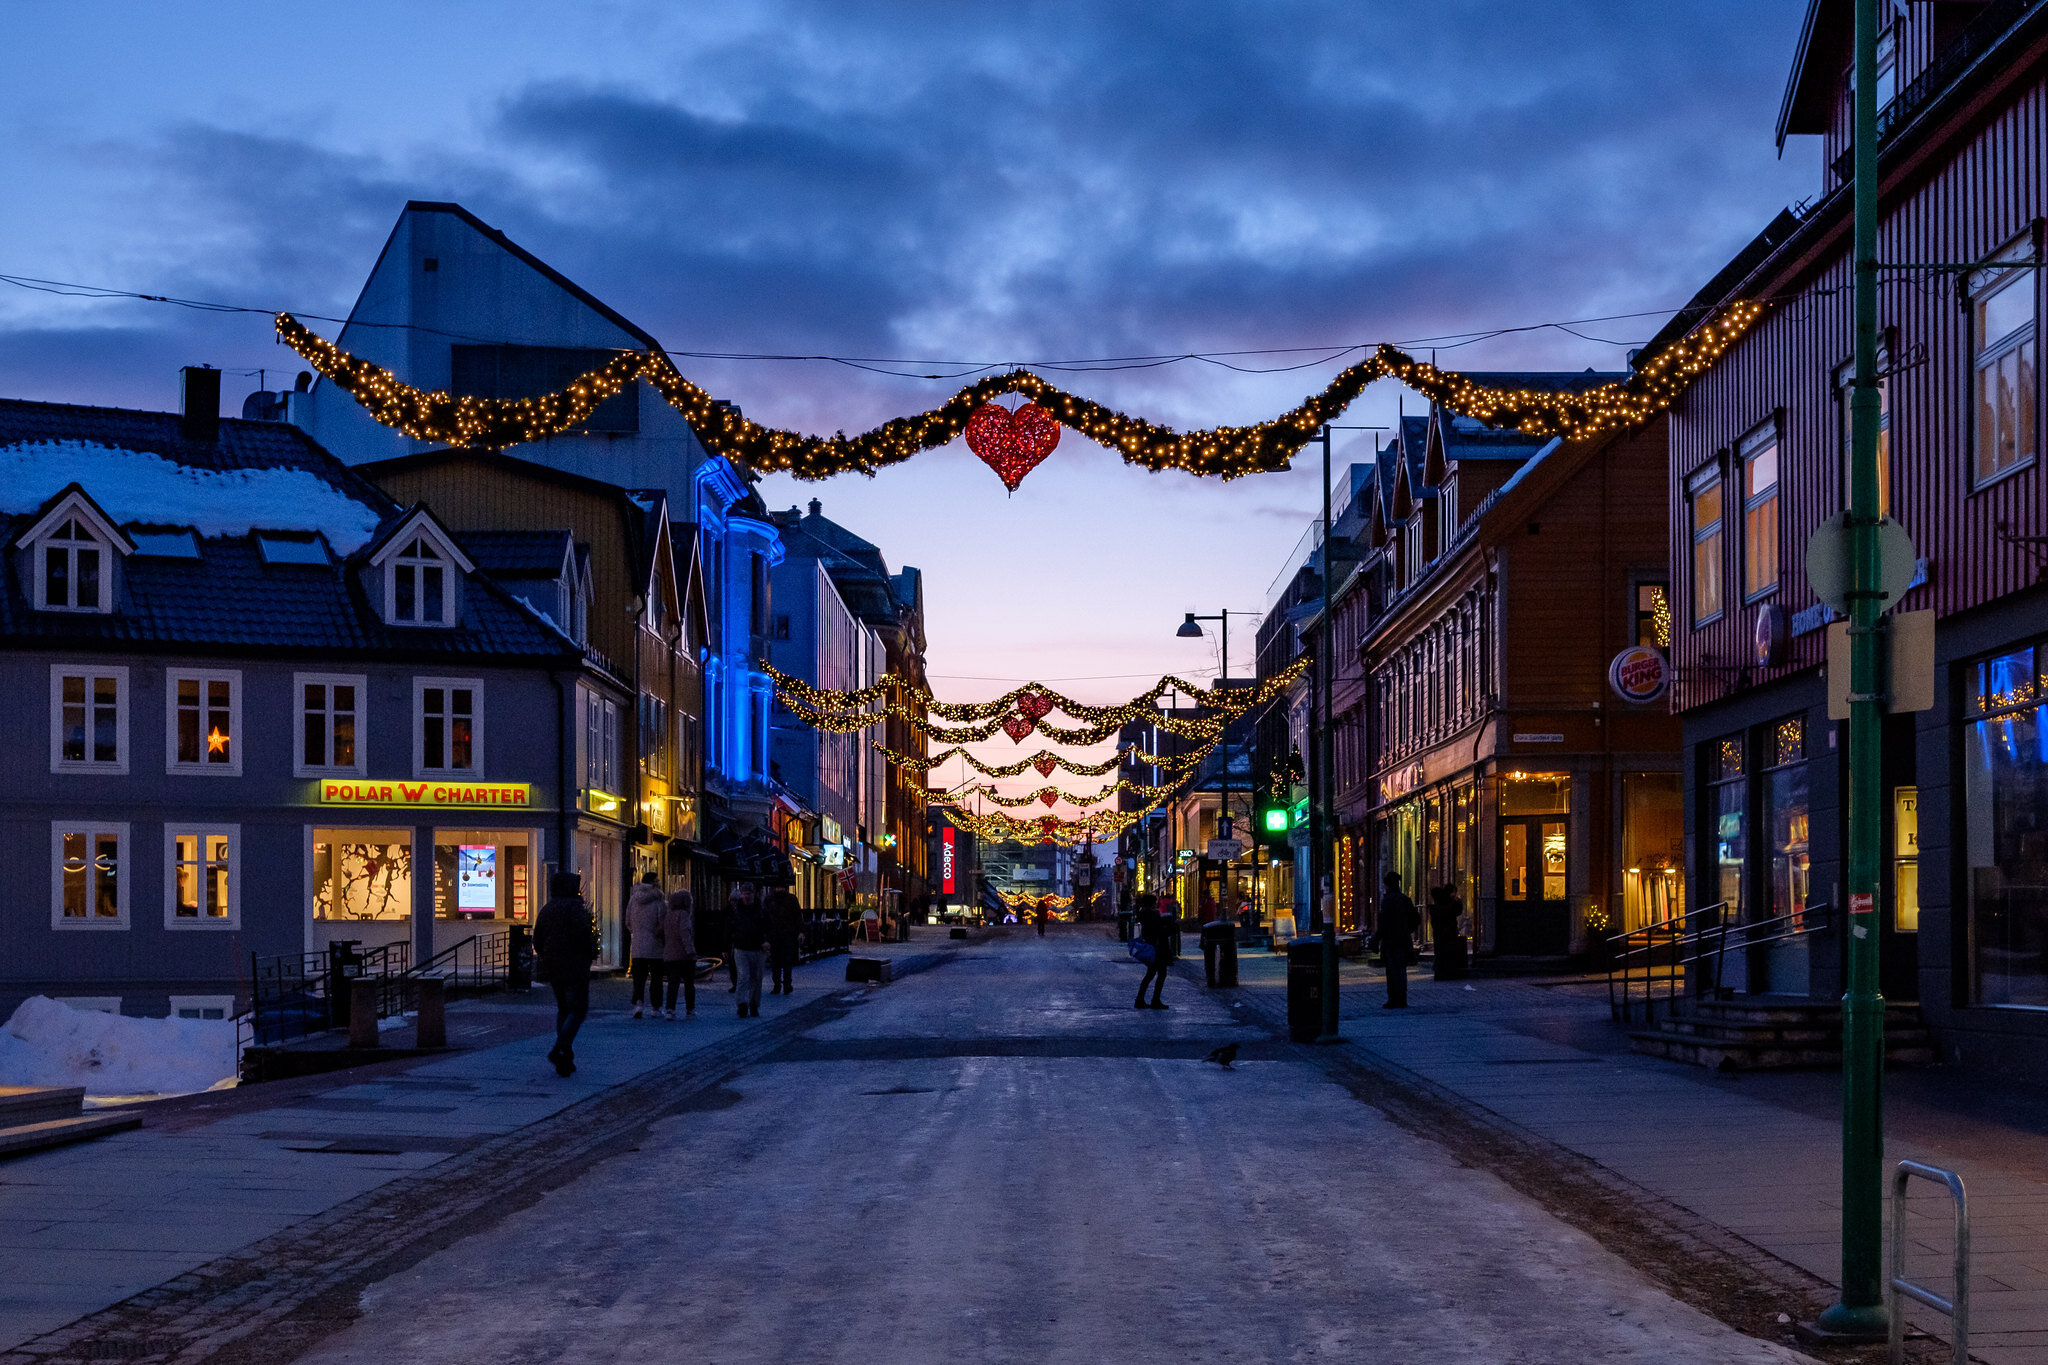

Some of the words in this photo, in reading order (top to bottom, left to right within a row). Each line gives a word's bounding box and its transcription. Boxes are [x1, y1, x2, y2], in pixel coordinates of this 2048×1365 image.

[1621, 657, 1660, 677] BURGER
[1623, 666, 1662, 689] KING
[326, 785, 393, 801] POLAR
[433, 787, 526, 804] CHARTER
[943, 841, 954, 879] Adecco
